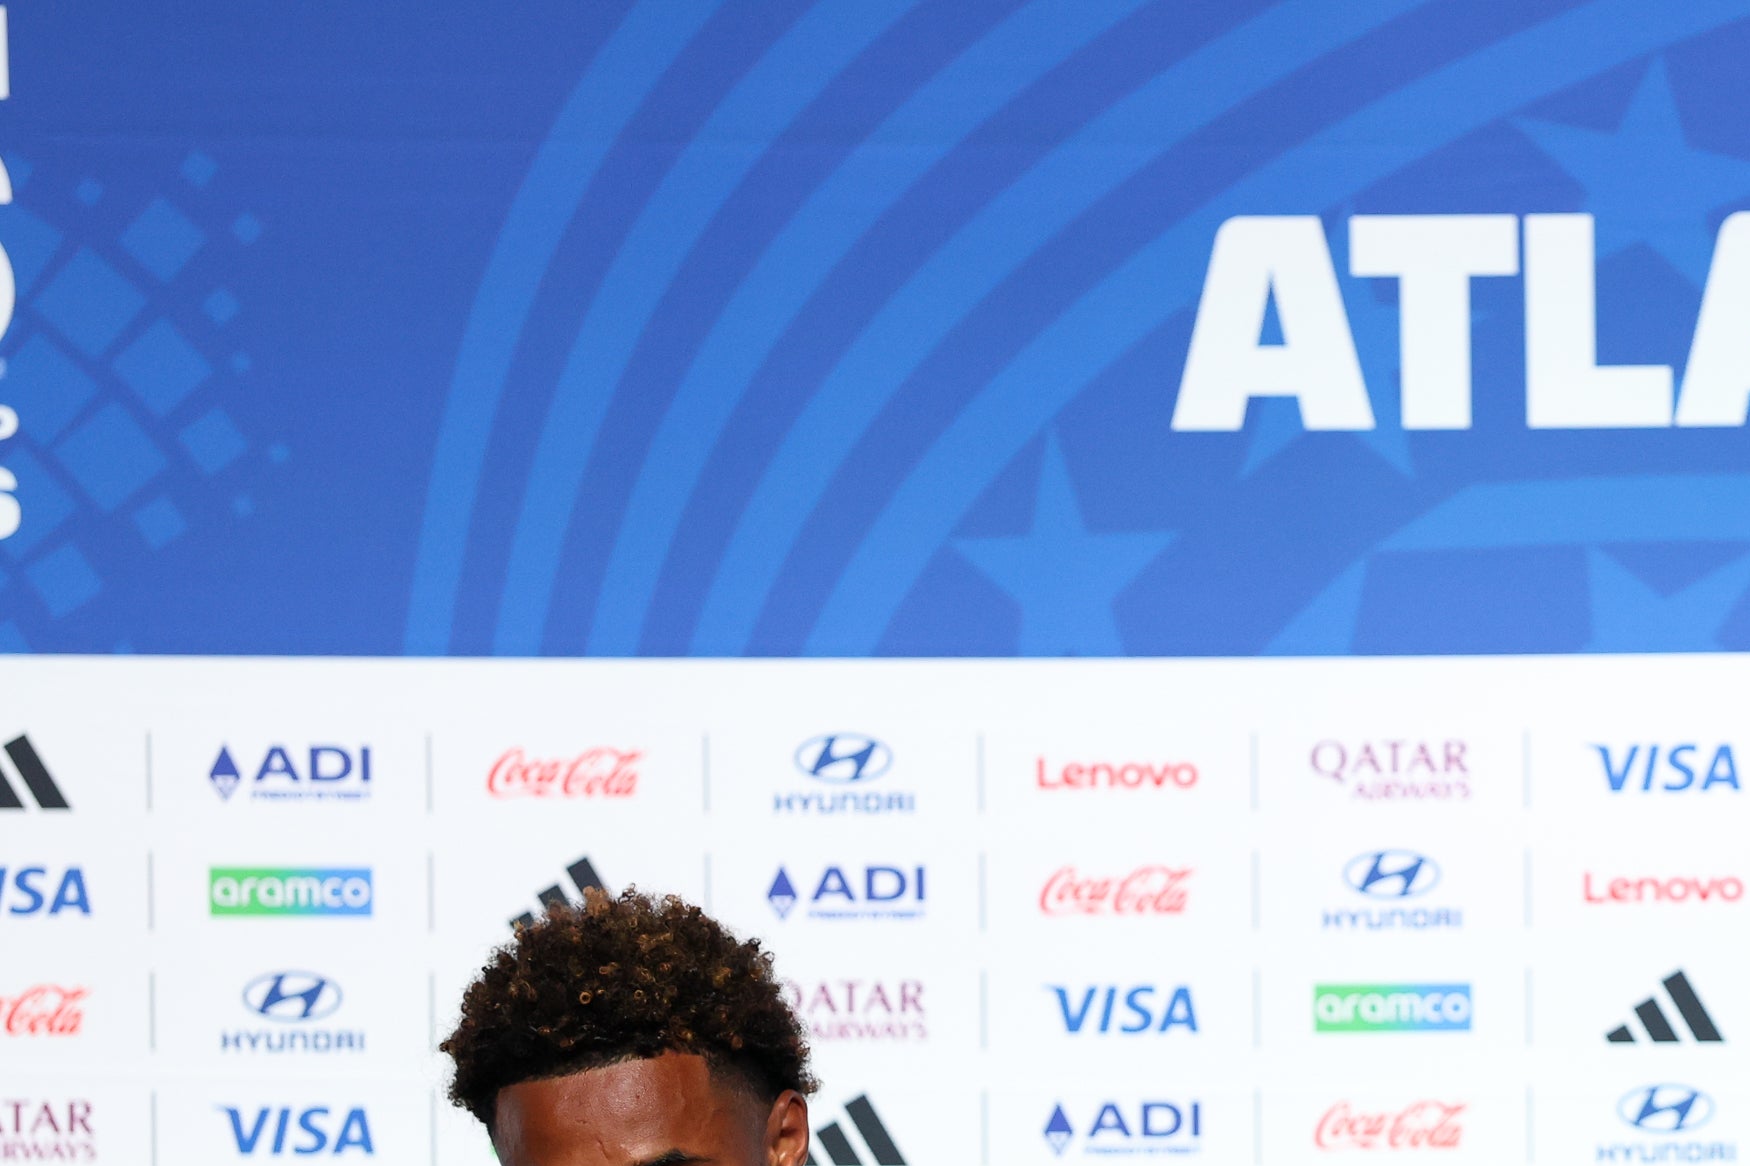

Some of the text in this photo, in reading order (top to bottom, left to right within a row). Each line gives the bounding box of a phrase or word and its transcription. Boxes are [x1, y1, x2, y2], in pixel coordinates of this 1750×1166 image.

[255, 746, 371, 782] ADI
[1036, 757, 1199, 790] Lenovo
[1310, 740, 1470, 779] QATAR
[1595, 744, 1741, 793] VISA
[773, 792, 915, 814] HYUNDAI
[213, 875, 369, 907] aramco
[812, 866, 925, 902] ADI
[1583, 872, 1744, 904] Lenovo
[1322, 908, 1462, 931] HYUNDAI
[1053, 986, 1198, 1034] VISA
[1317, 992, 1470, 1023] aramco
[221, 1031, 365, 1052] HYUNDAI
[224, 1106, 374, 1155] VISA
[1088, 1102, 1200, 1138] ADI
[1596, 1142, 1736, 1164] HYUNDAI
